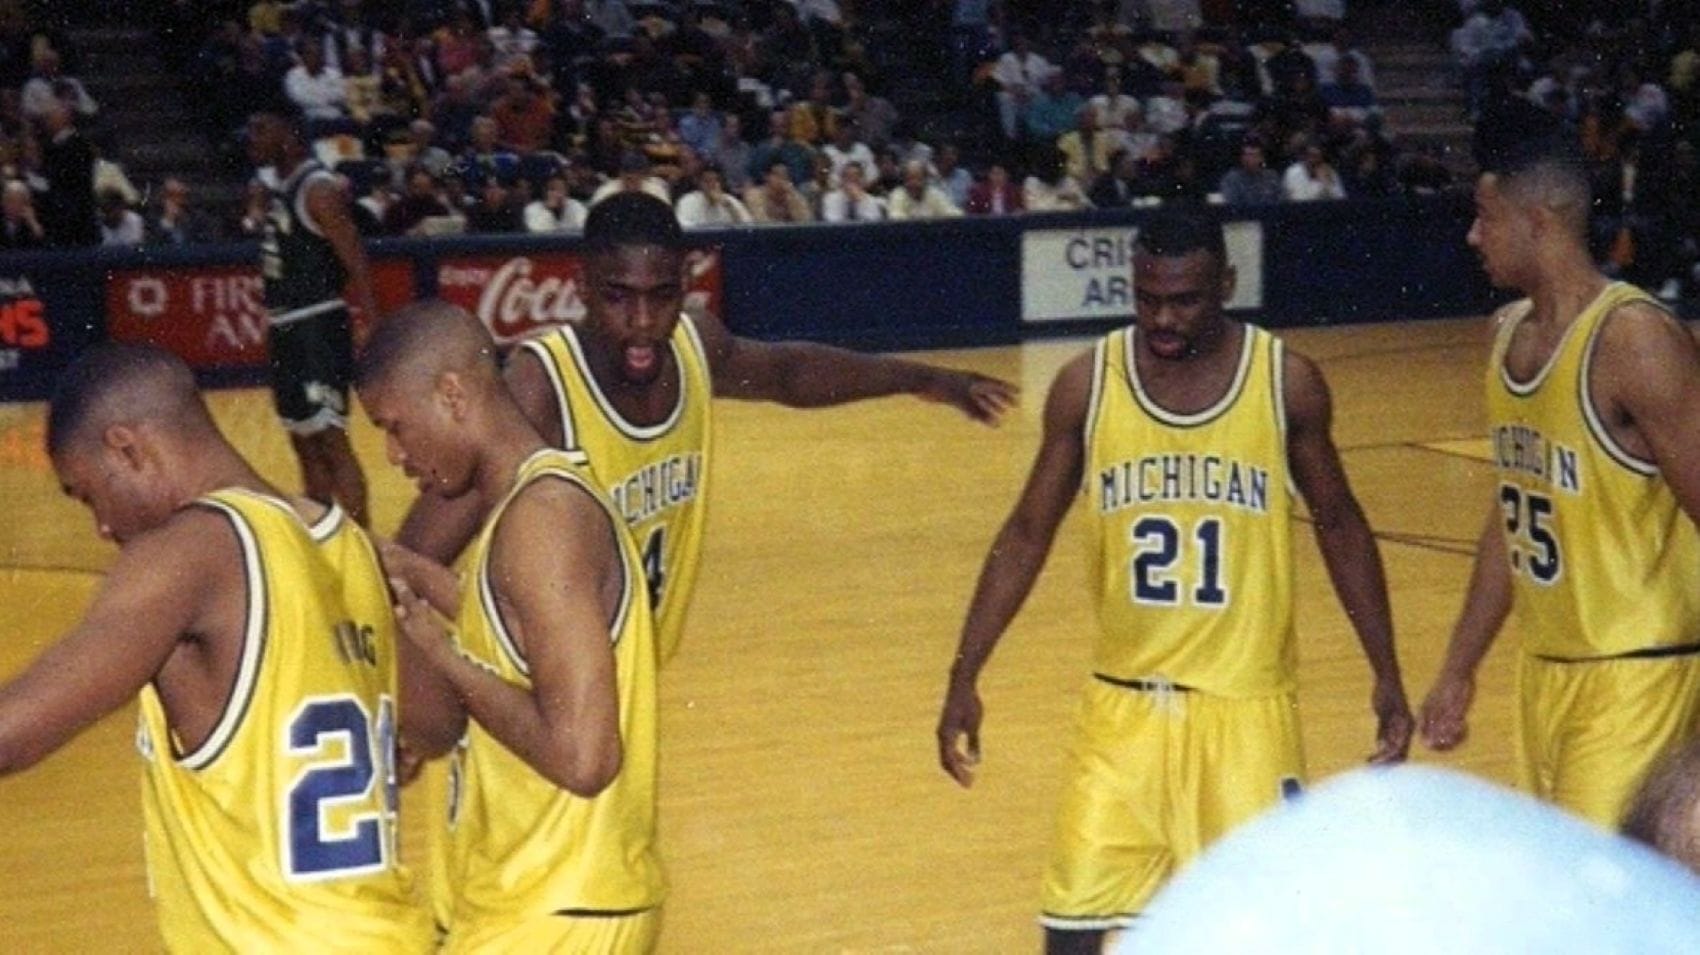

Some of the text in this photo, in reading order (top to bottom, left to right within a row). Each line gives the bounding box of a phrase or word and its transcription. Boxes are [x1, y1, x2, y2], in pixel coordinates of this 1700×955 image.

[1066, 238, 1137, 270] CRI
[1100, 455, 1268, 511] MICHIGAN
[1132, 515, 1226, 605] 21
